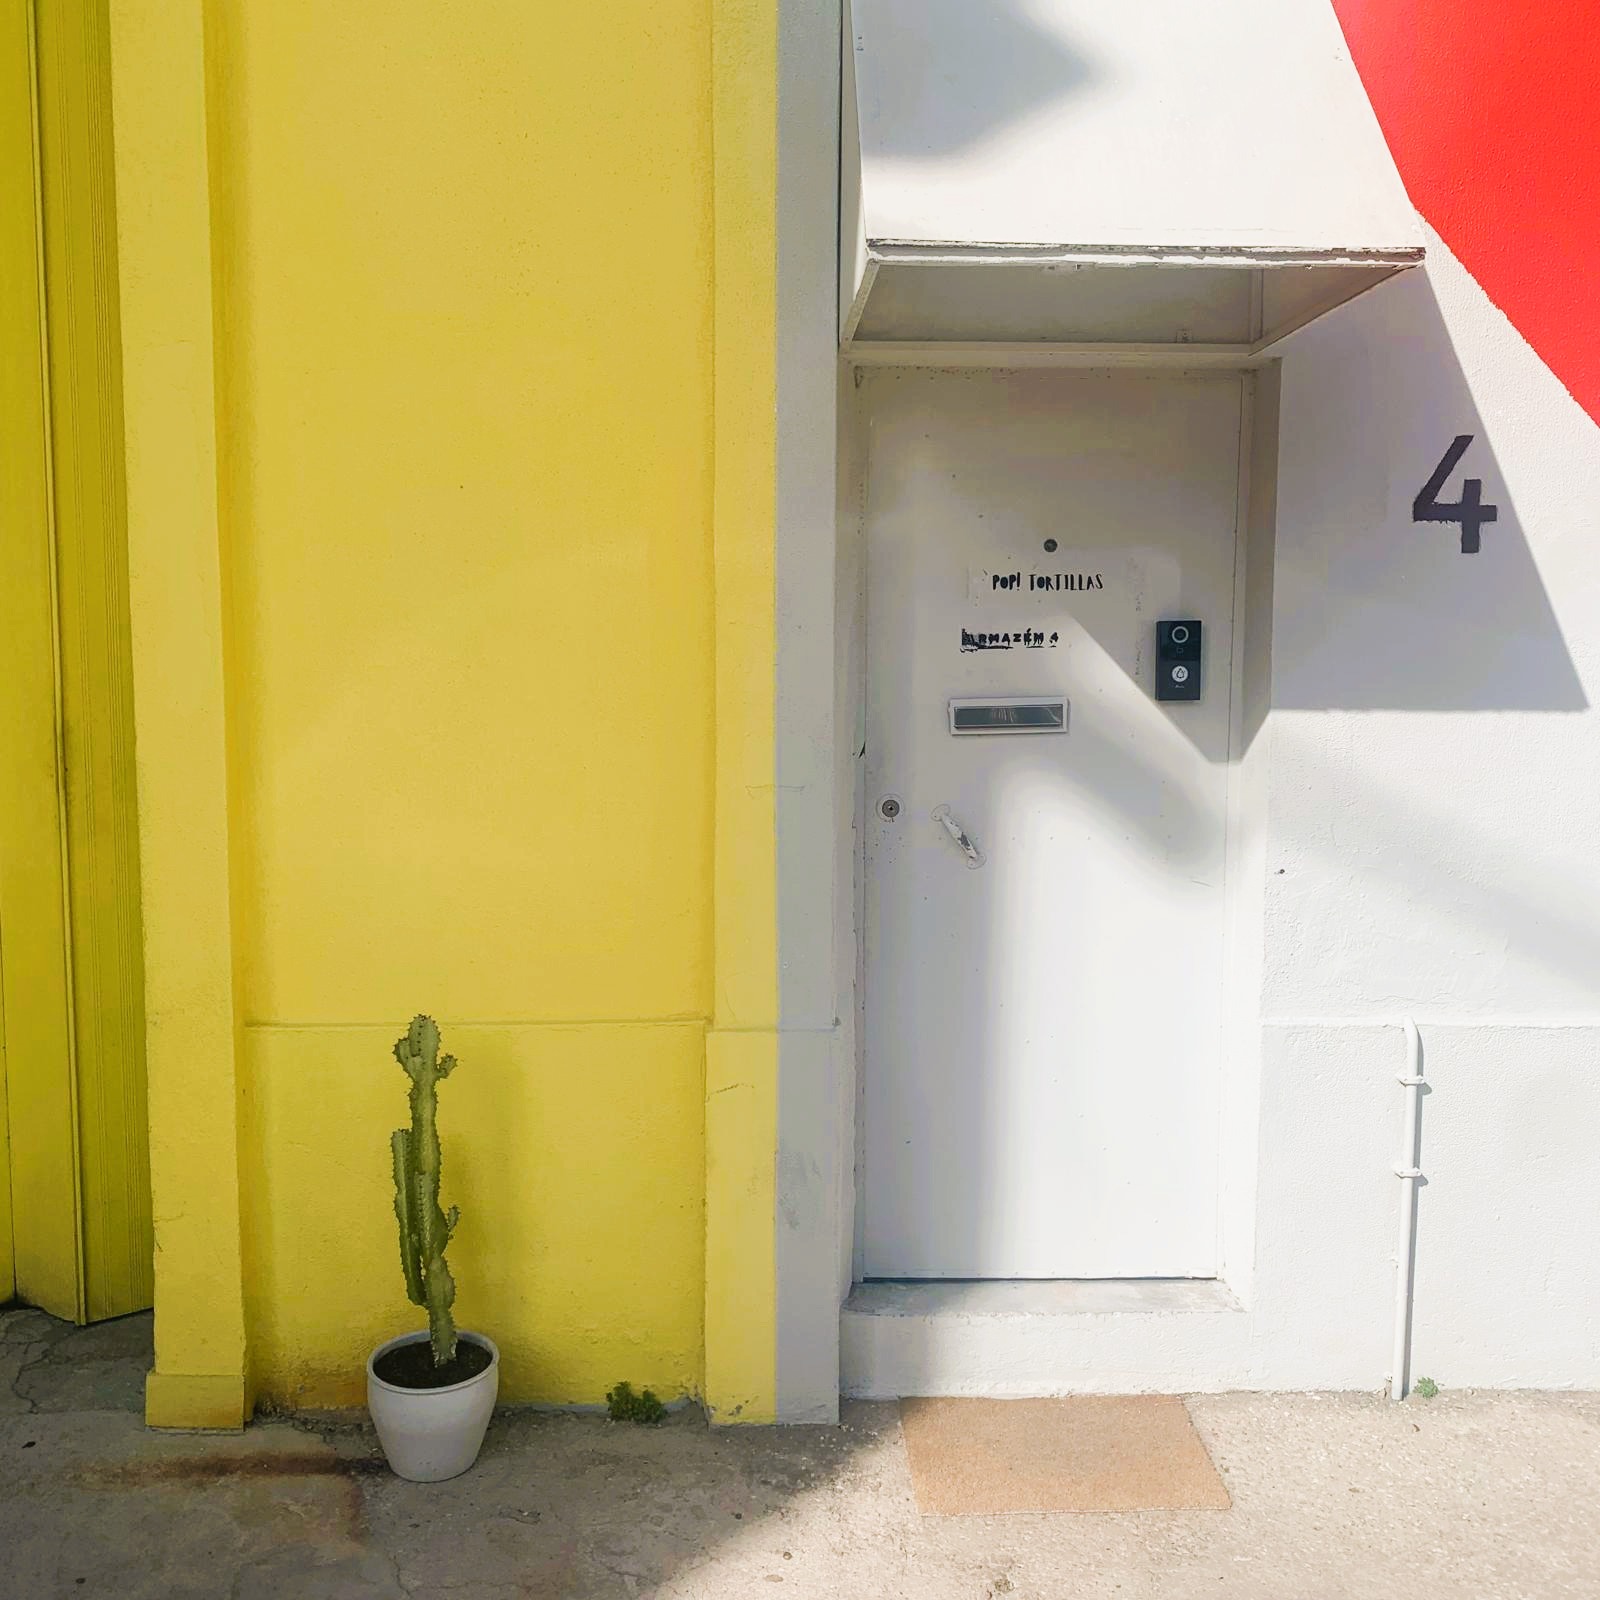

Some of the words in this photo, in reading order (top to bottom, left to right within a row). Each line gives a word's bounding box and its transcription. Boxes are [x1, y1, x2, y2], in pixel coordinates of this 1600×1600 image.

[1413, 435, 1497, 553] 4
[992, 572, 1020, 591] POP!
[1028, 573, 1103, 591] TORTILLAS
